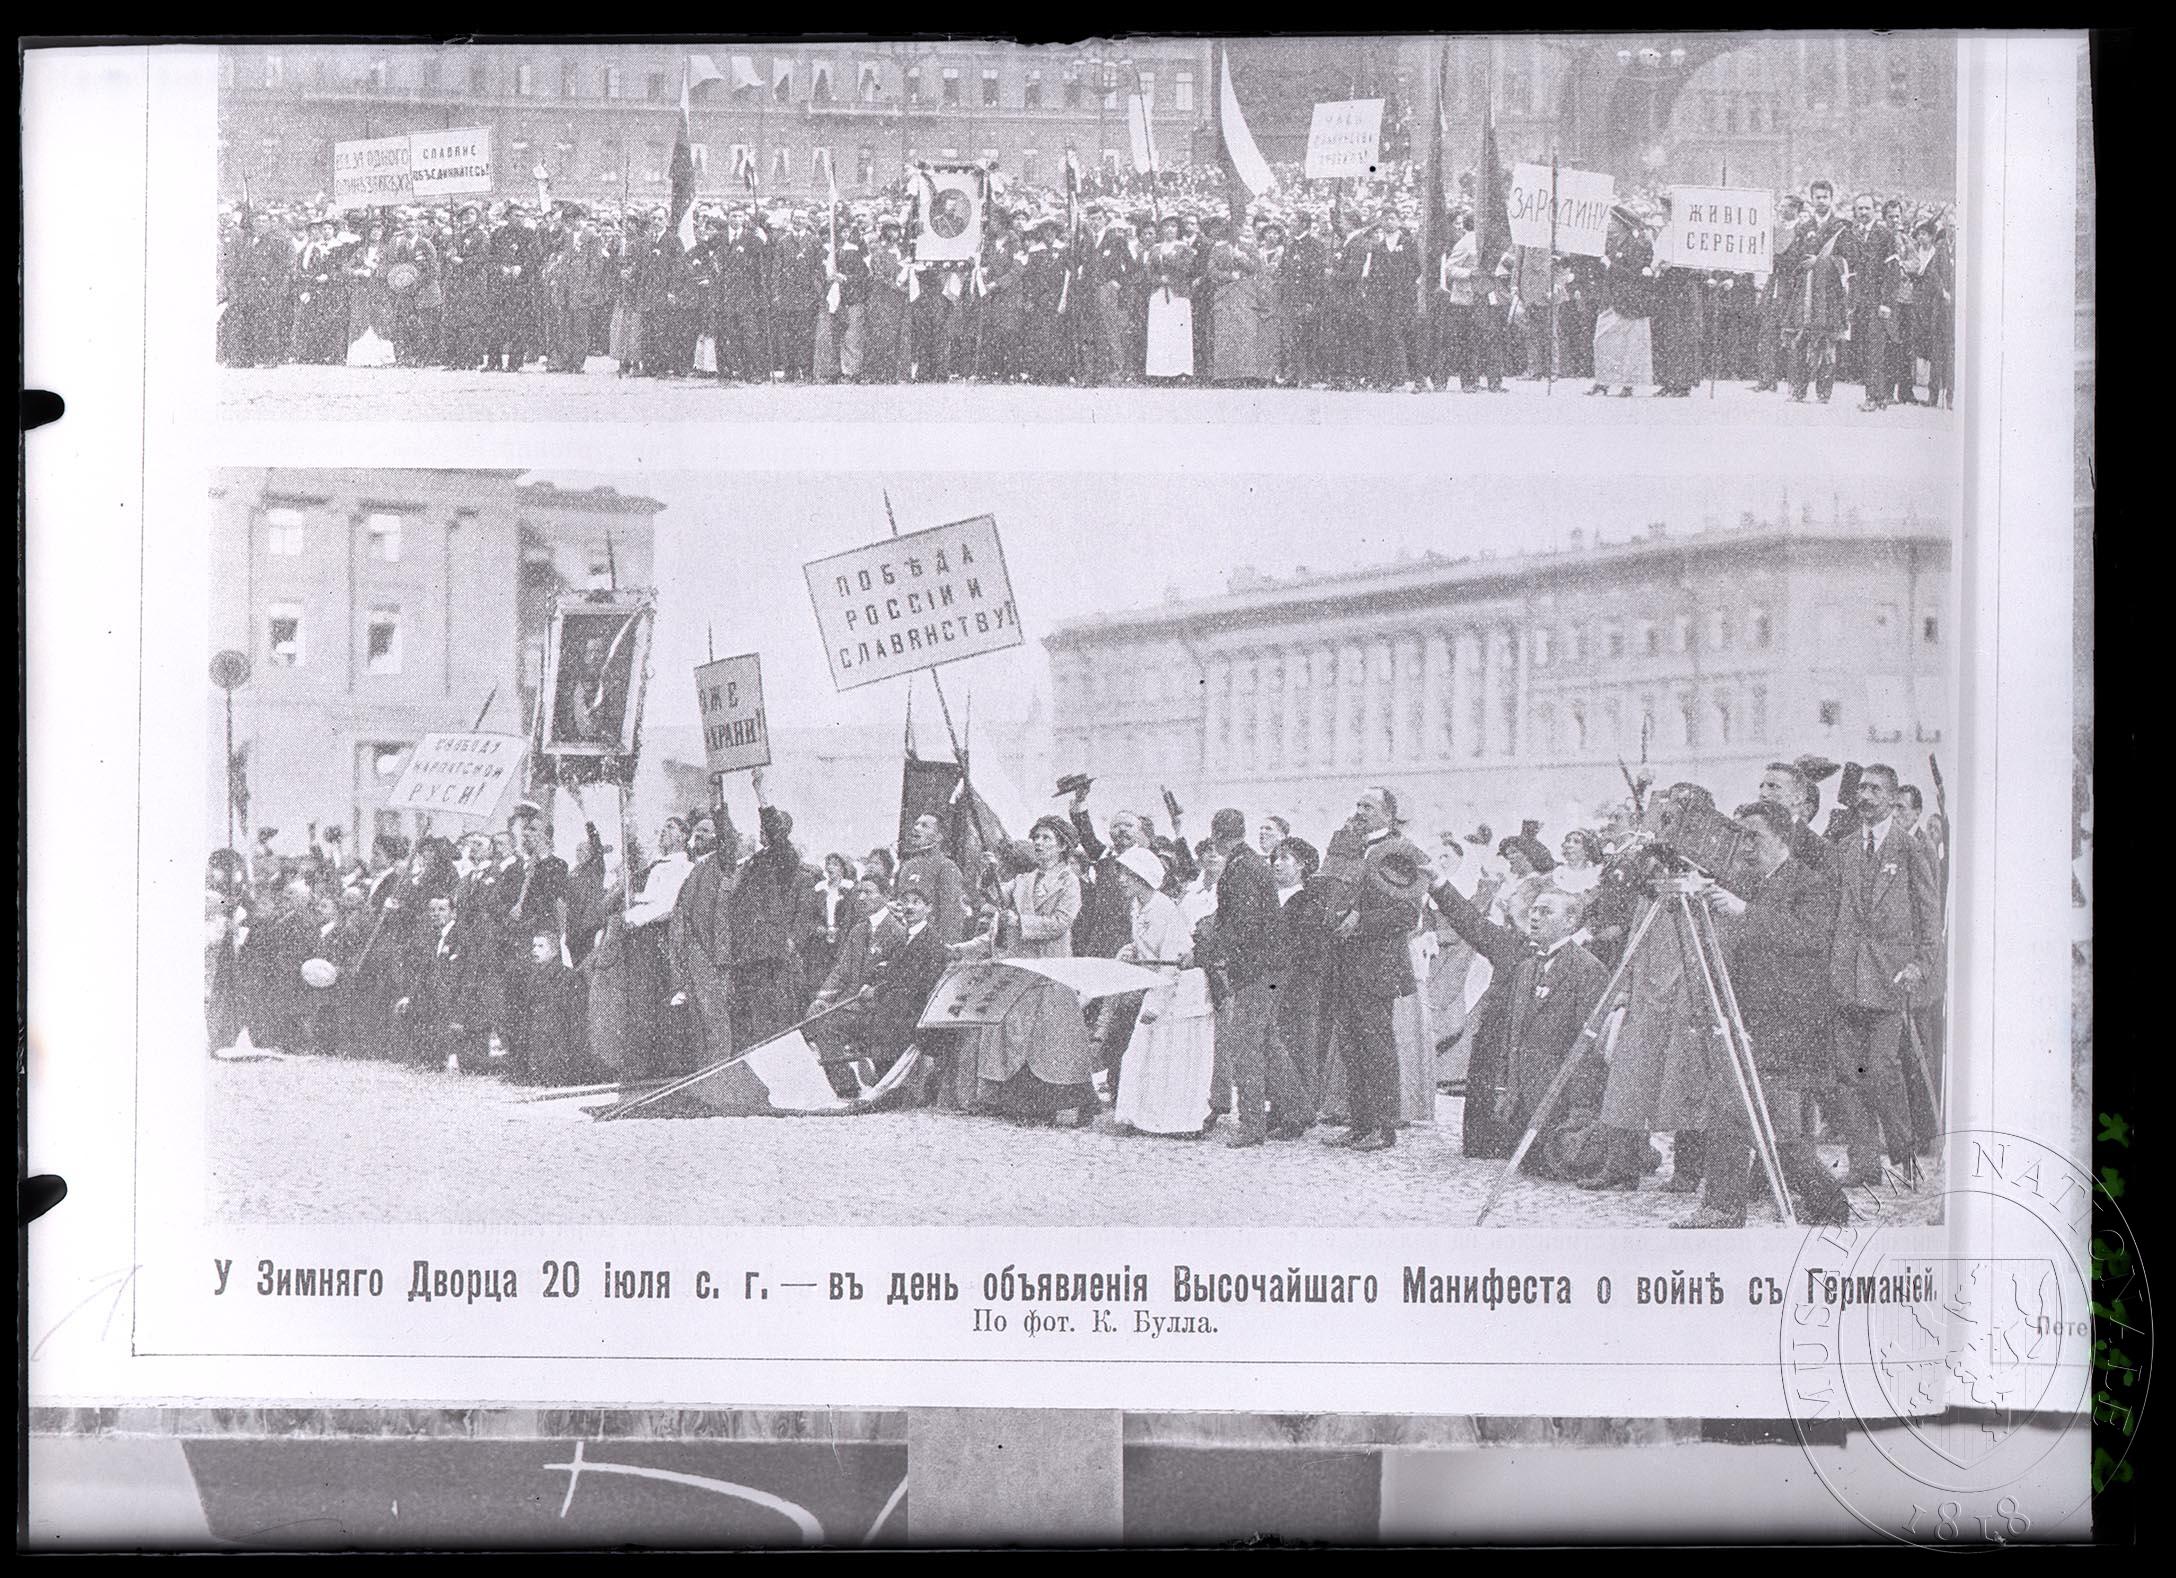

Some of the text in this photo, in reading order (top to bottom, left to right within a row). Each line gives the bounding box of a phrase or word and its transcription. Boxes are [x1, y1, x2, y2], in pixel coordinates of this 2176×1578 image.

[422, 144, 477, 160] СЛАВЯНЕ
[1688, 204, 1758, 226] ЖИВІО
[1686, 231, 1766, 255] СЕРБІЯ!
[836, 543, 975, 597] ПОБѢДА
[845, 577, 984, 631] РОССІИ И
[839, 600, 1016, 670] СЛАВЯНСТВУ!
[408, 782, 486, 806] РУСИ!
[215, 1259, 232, 1295] У
[257, 1259, 383, 1297] Зимняго
[407, 1261, 517, 1305] Дворца
[543, 1261, 580, 1298] 20
[604, 1262, 670, 1299] іюля
[696, 1271, 719, 1299] с.
[829, 1272, 864, 1300] въ
[887, 1272, 959, 1305] день
[983, 1264, 1147, 1302] объявленія
[1174, 1265, 1378, 1303] Высочайшаго
[1403, 1266, 1572, 1308] Манифеста
[1597, 1276, 1611, 1304] о
[1637, 1269, 1724, 1305] войнѣ
[1749, 1276, 1782, 1305] съ
[973, 1308, 1218, 1339] По фот. К. Булла.
